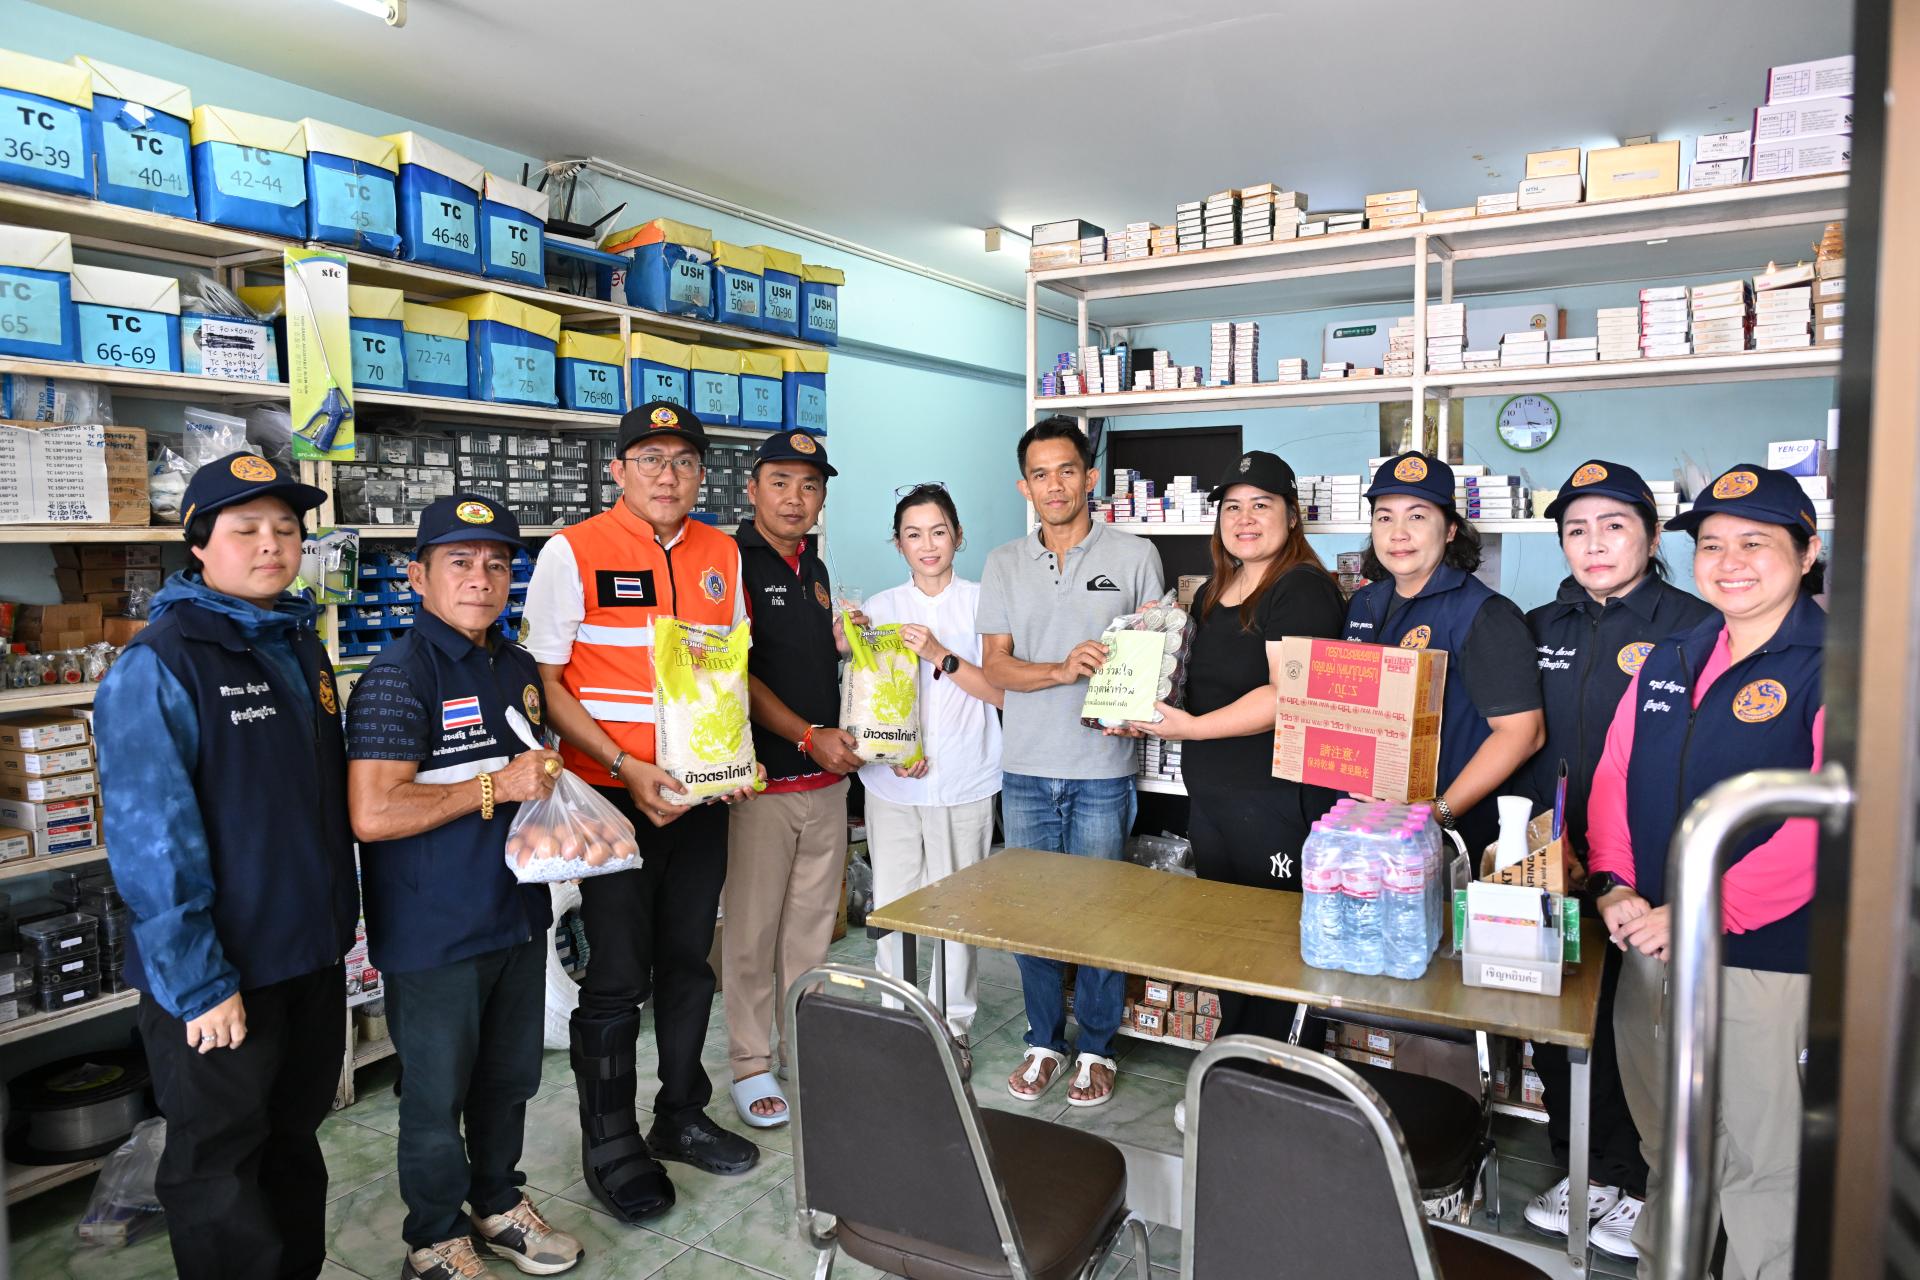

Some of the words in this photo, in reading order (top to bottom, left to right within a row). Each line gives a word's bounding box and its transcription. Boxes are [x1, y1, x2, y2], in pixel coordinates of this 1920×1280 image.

[17, 106, 55, 131] TC
[130, 133, 163, 156] TC
[4, 138, 70, 169] 36-39
[236, 145, 272, 167] TC
[230, 170, 282, 193] 42-44
[344, 182, 371, 201] TC
[440, 202, 462, 220] TC
[350, 211, 370, 229] 45
[432, 228, 469, 249] 46-48
[508, 225, 529, 242] TC
[511, 252, 527, 267] 50
[321, 267, 341, 279] sfc
[680, 265, 704, 280] USH
[1, 281, 32, 302] TC
[732, 278, 754, 293] USH
[771, 285, 792, 299] USH
[771, 305, 792, 319] 70-90
[814, 298, 832, 311] USH
[1, 315, 29, 334] 65
[106, 314, 142, 333] TC
[809, 315, 836, 330] 100-150
[362, 337, 386, 354] TC
[97, 343, 156, 365] 66-69
[416, 349, 451, 365] 72-74
[514, 357, 536, 371] TC
[367, 365, 384, 380] 70
[588, 369, 609, 382] TC
[519, 379, 535, 393] 75
[657, 375, 672, 387] TC
[706, 382, 723, 394] TC
[583, 390, 613, 406] 76-80
[755, 388, 768, 400] TC
[808, 394, 818, 406] TC
[709, 399, 722, 412] 90
[757, 405, 767, 417] 95
[302, 546, 317, 555] sfc
[1180, 579, 1189, 588] 30
[685, 762, 753, 784] ข้าวตราไก่แจ้
